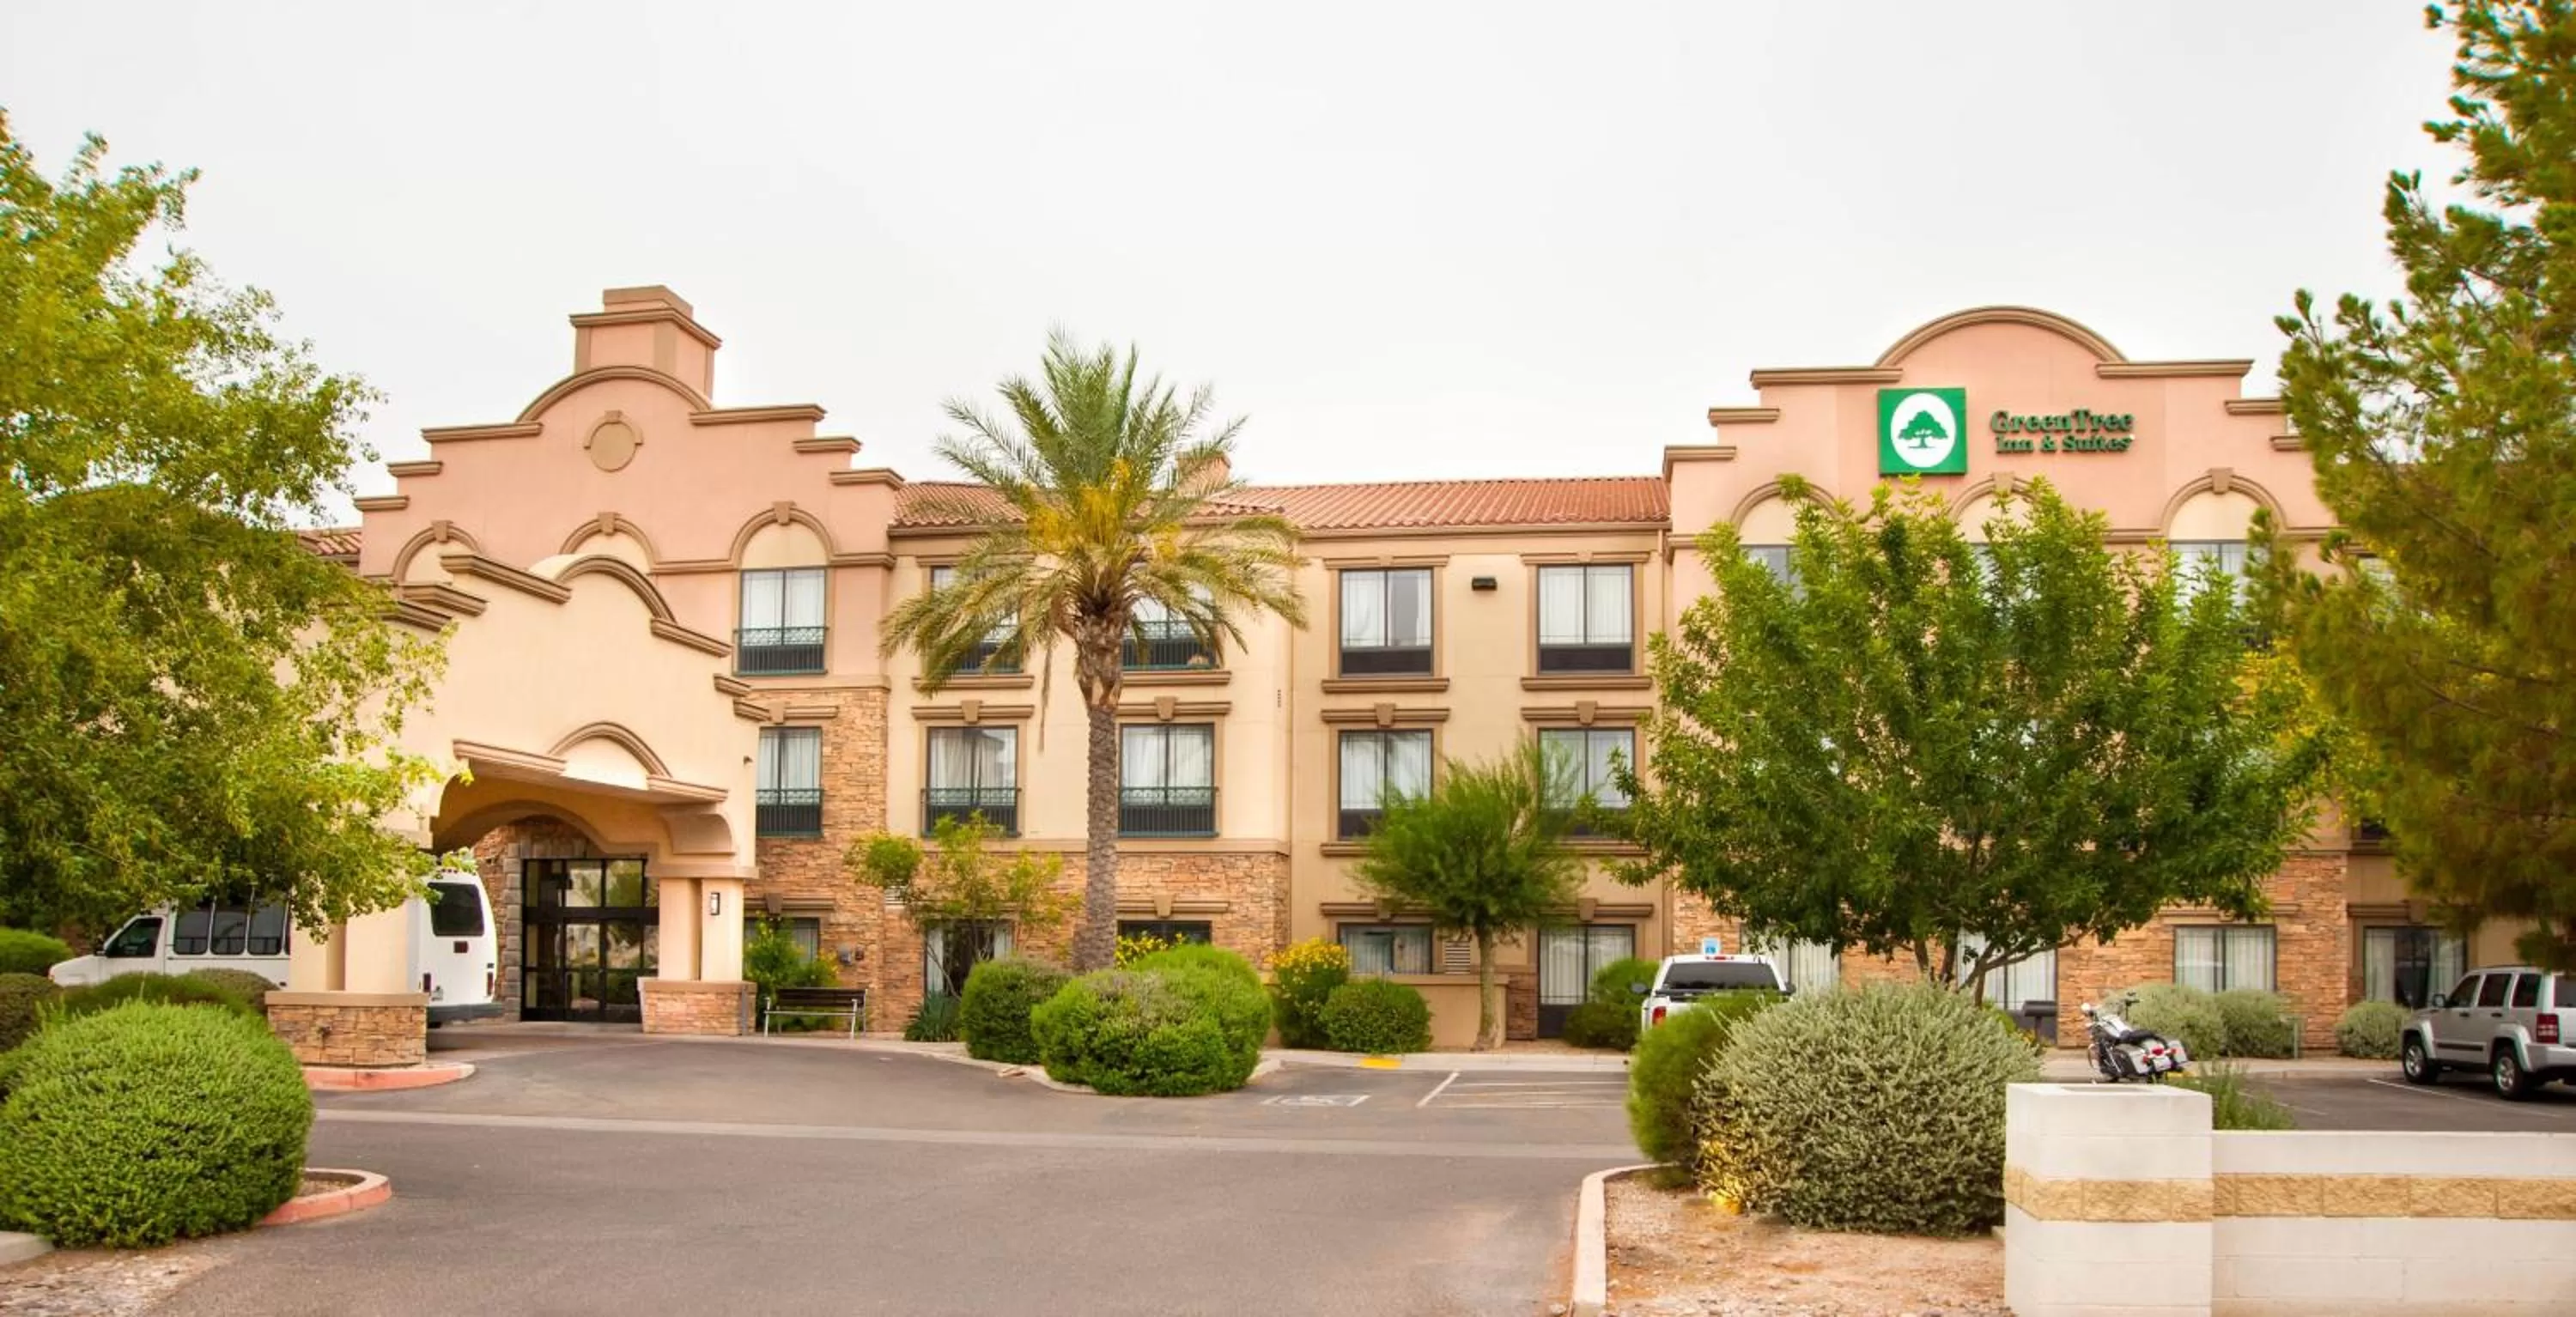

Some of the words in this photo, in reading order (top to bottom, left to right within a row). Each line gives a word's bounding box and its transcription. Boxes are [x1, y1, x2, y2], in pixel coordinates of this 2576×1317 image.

[1991, 409, 2134, 432] GreenTree
[1996, 434, 2033, 452] Inn
[2040, 434, 2057, 452] &
[2062, 434, 2131, 452] Suites
